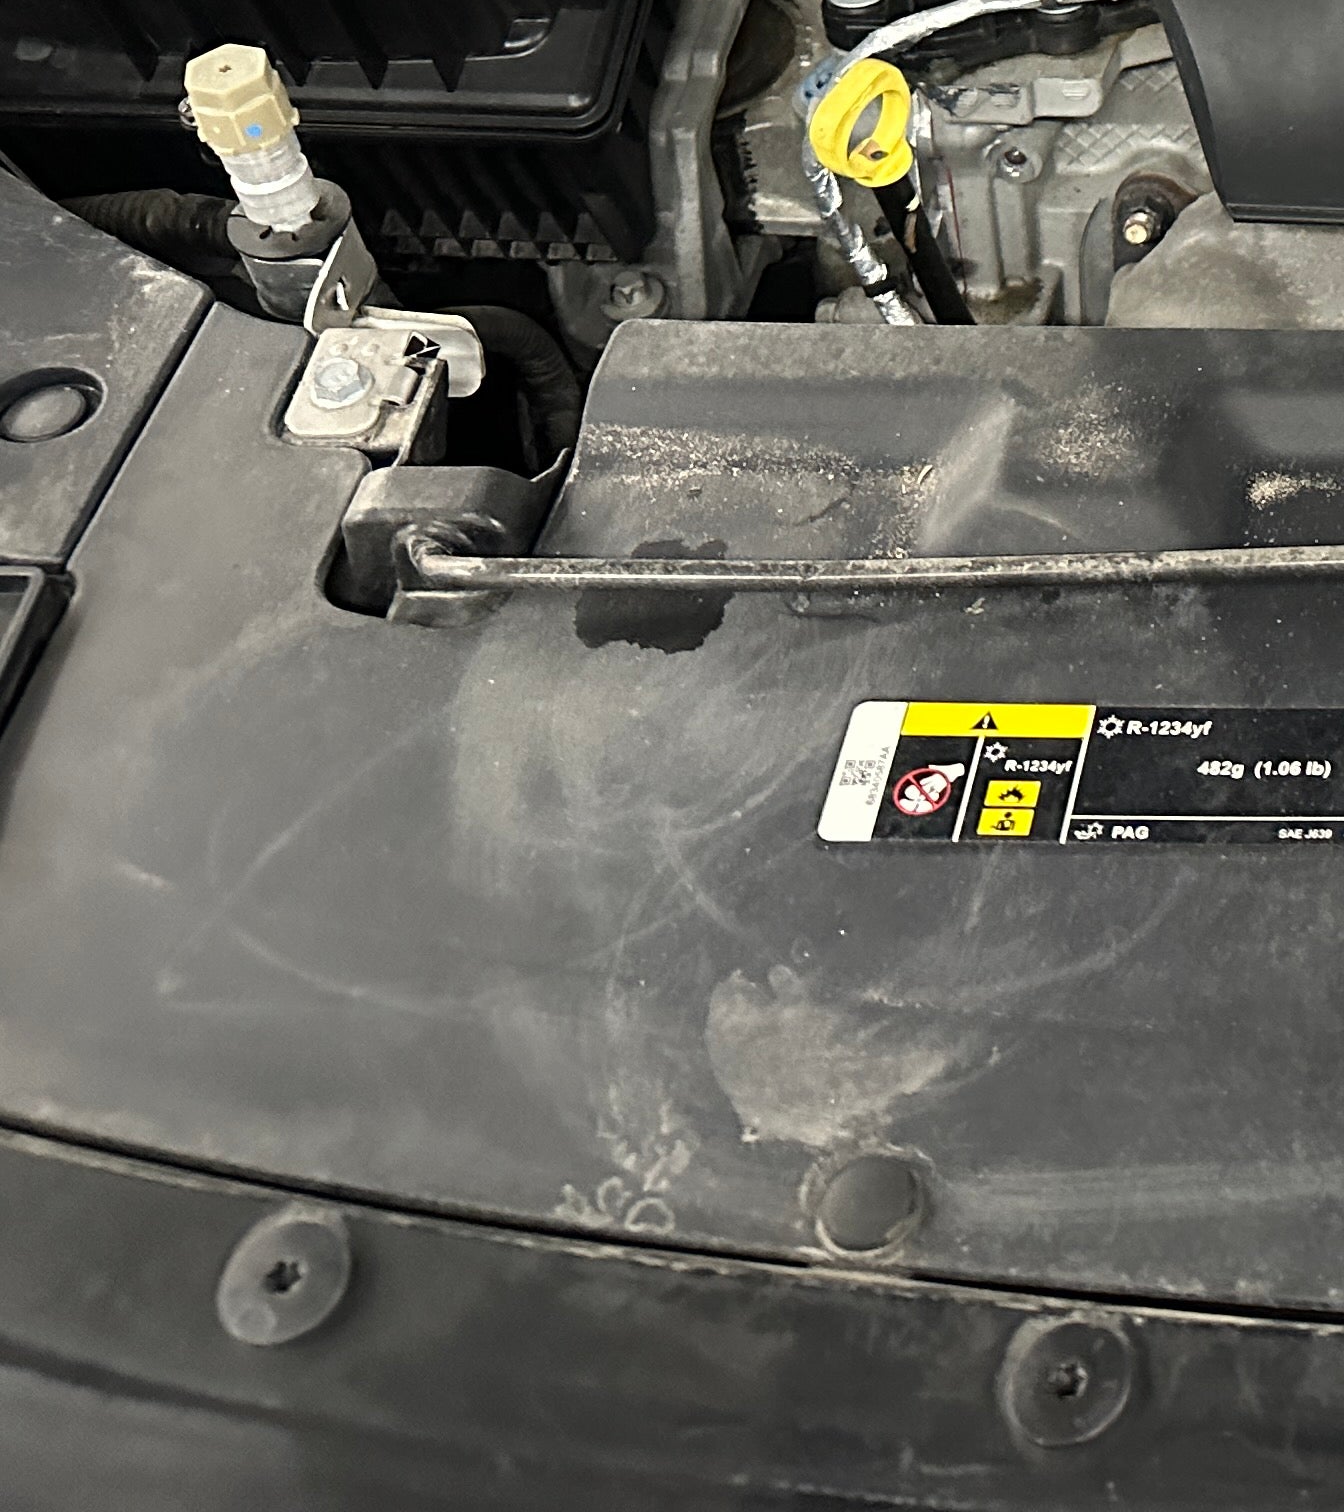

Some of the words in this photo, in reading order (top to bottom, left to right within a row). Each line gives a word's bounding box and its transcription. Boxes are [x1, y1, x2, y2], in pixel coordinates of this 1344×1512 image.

[1126, 720, 1213, 740] R-1234yf
[1003, 756, 1073, 775] R-1234yf
[1196, 761, 1245, 780] 482g
[1252, 760, 1302, 780] (1.06
[1304, 760, 1333, 780] lb)
[1111, 825, 1150, 840] PAG
[1278, 828, 1303, 840] SAE
[1303, 828, 1333, 840] J639
